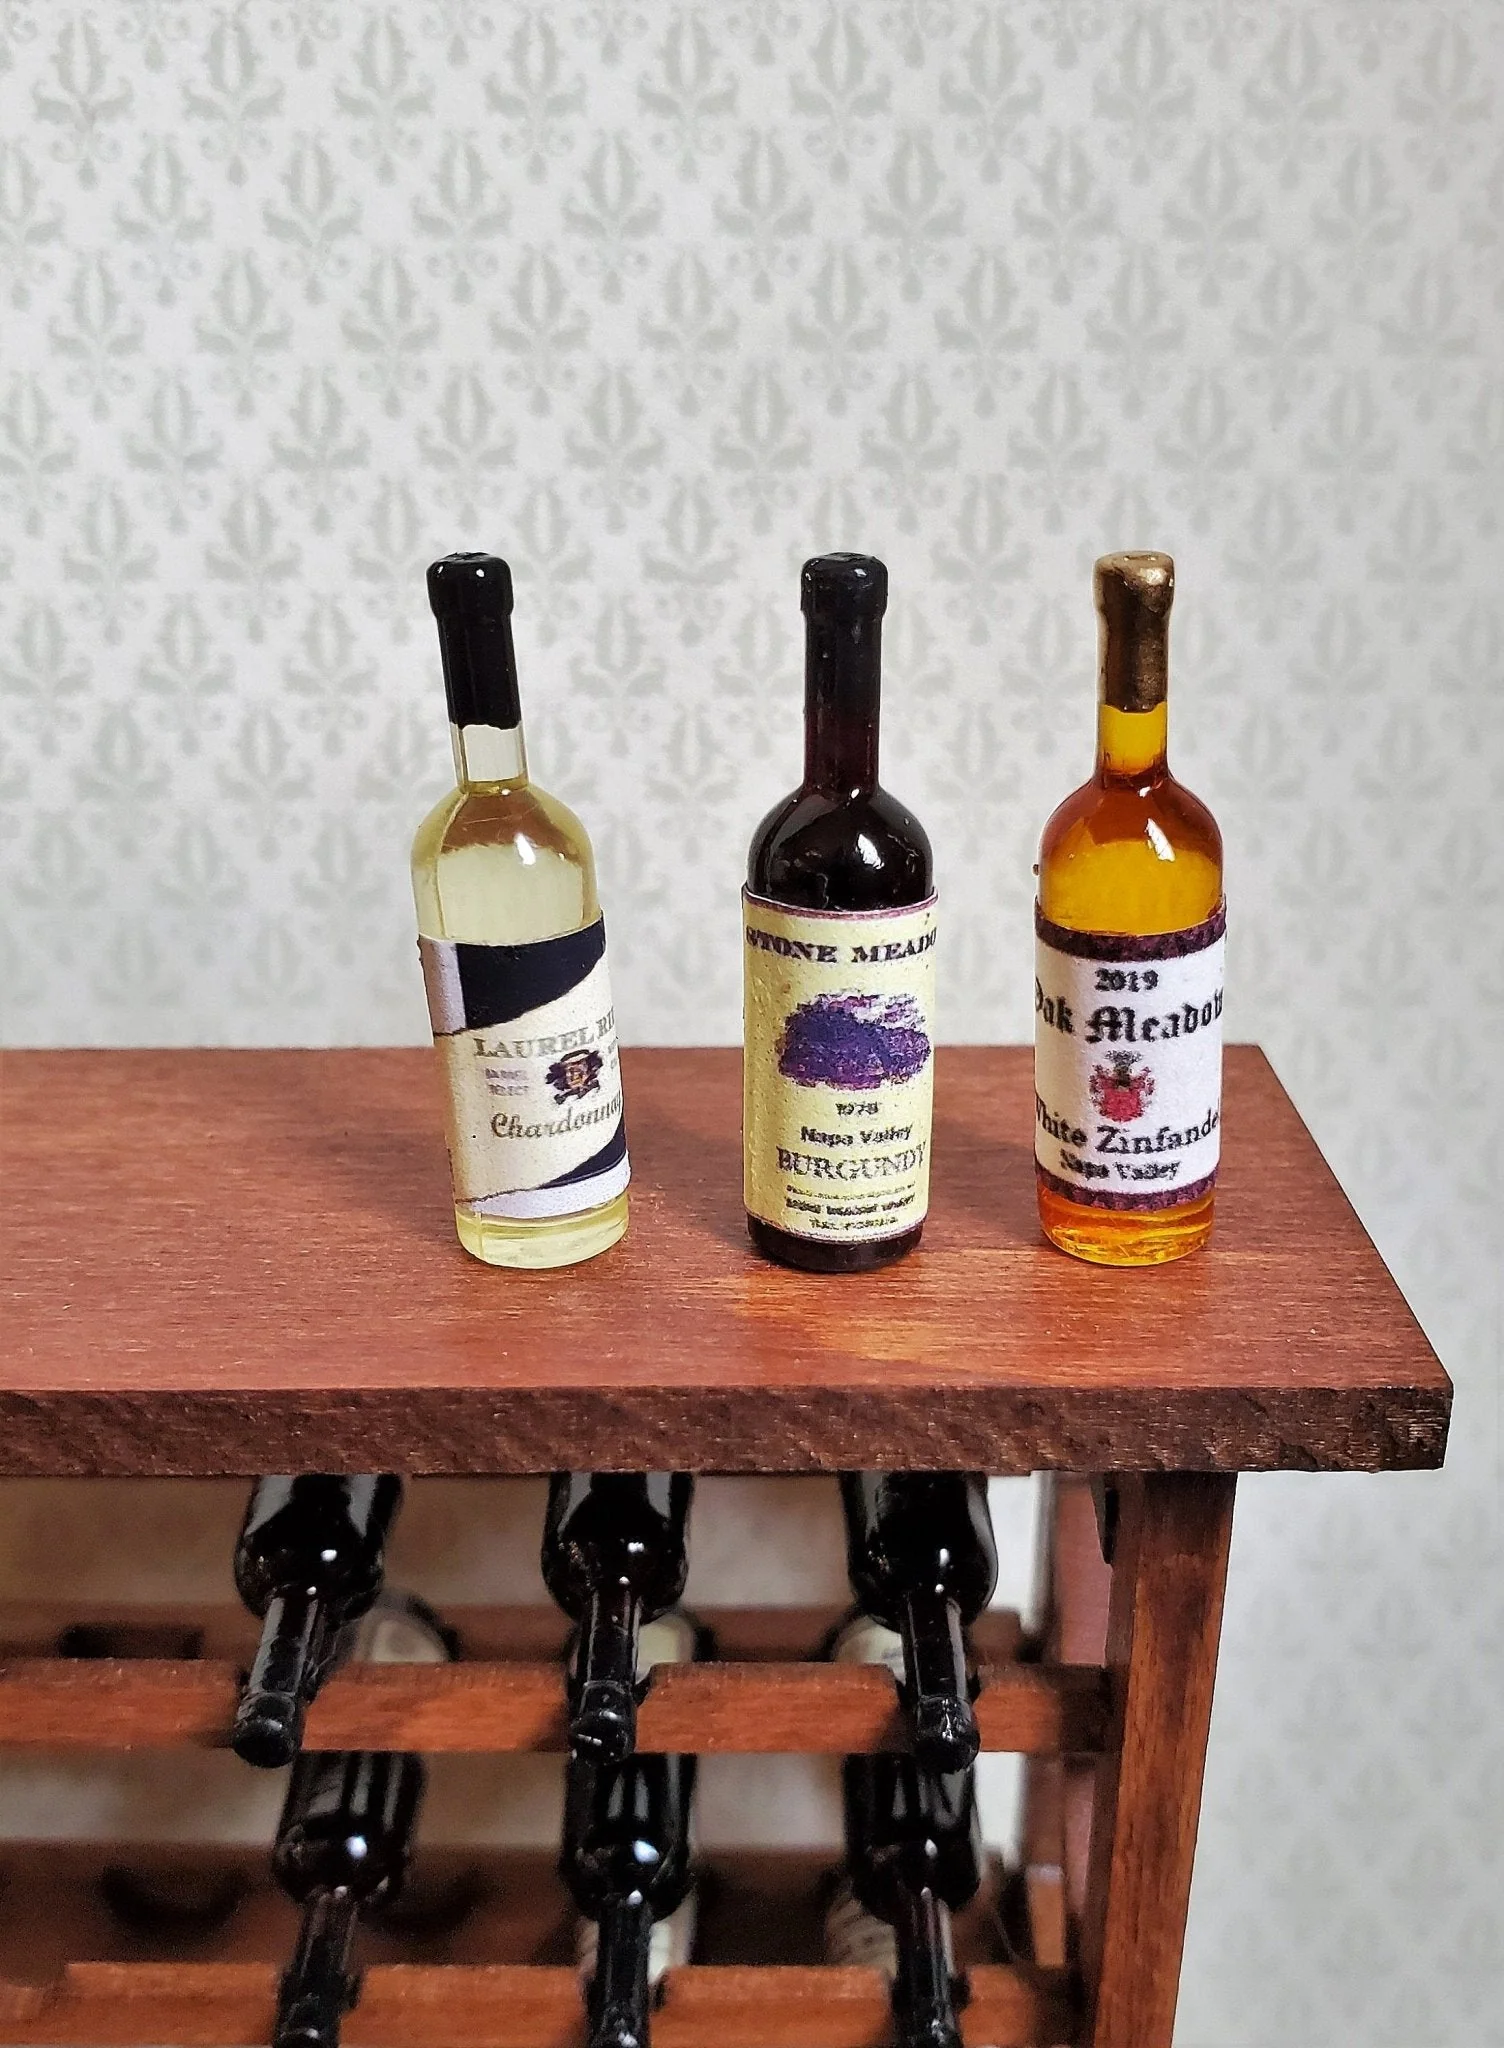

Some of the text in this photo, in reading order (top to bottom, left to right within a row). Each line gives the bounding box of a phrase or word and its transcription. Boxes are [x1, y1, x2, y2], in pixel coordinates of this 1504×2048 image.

[746, 925, 837, 963] STONE
[1094, 967, 1159, 993] 2019
[473, 1027, 594, 1058] LAUREL
[776, 1140, 926, 1181] BURGUNDY
